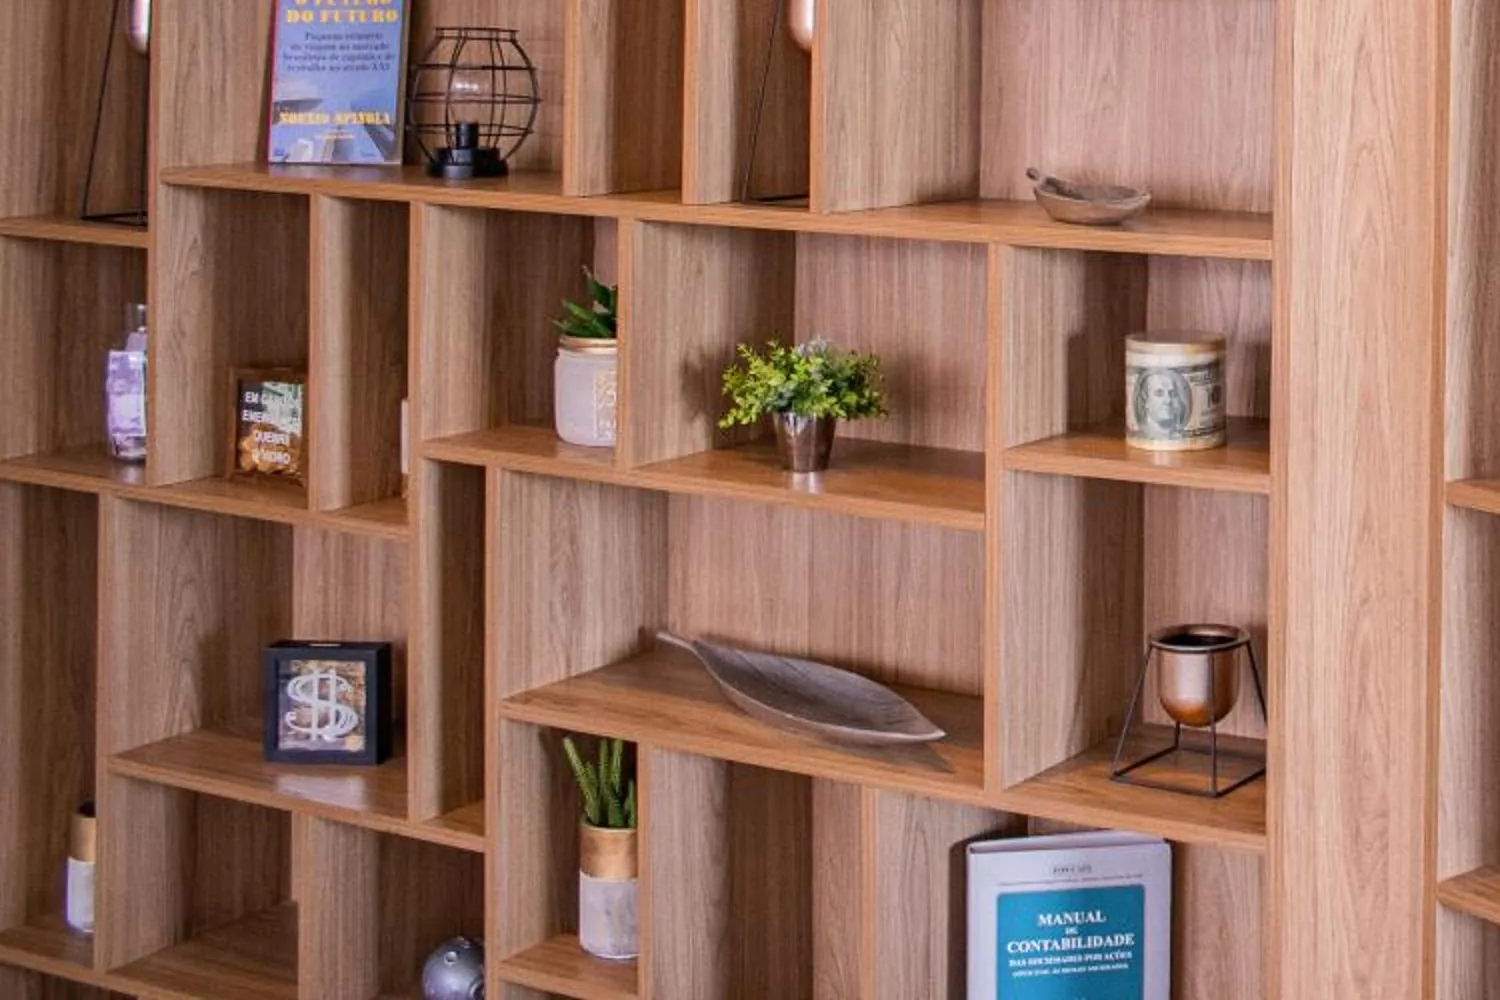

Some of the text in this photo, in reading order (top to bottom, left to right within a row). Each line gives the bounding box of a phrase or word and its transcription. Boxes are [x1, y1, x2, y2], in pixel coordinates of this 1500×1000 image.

[286, 9, 313, 23] DO
[1037, 909, 1107, 928] MANUAL
[1007, 933, 1135, 954] CONTABILIDADE
